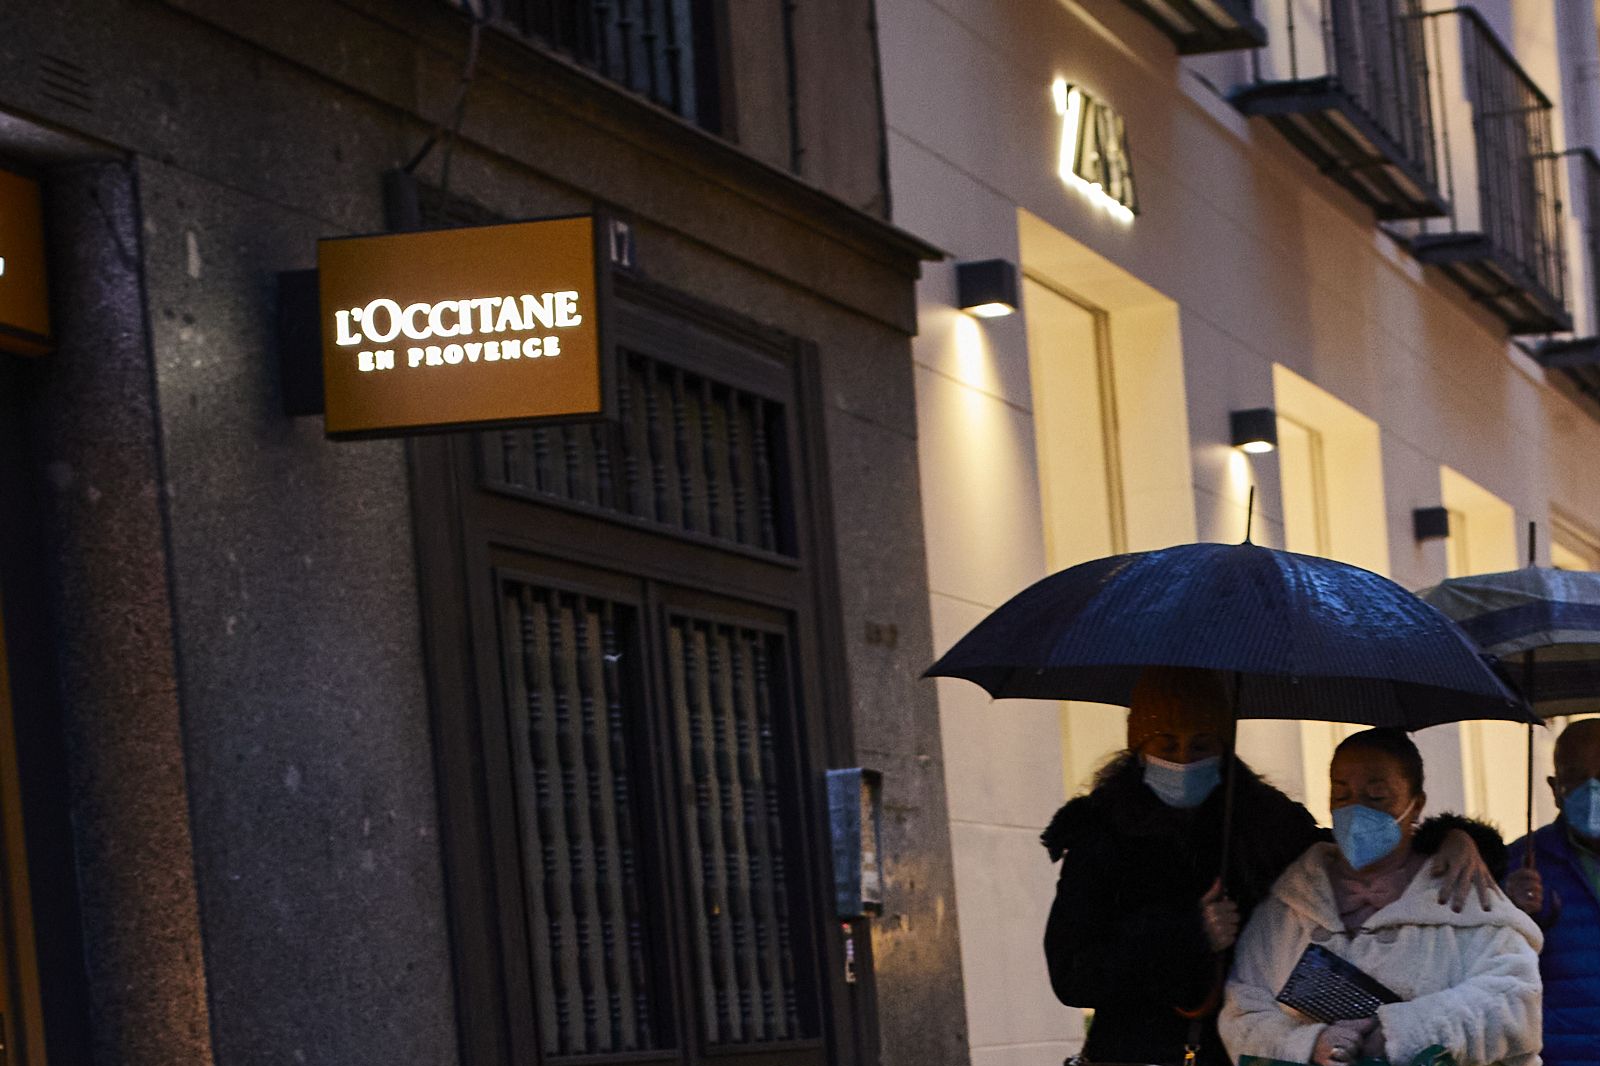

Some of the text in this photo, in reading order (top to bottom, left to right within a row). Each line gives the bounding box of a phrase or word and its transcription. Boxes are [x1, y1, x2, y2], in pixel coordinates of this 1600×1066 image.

[334, 290, 582, 345] L'OCCITANE
[357, 335, 561, 372] EN PROVENCE
